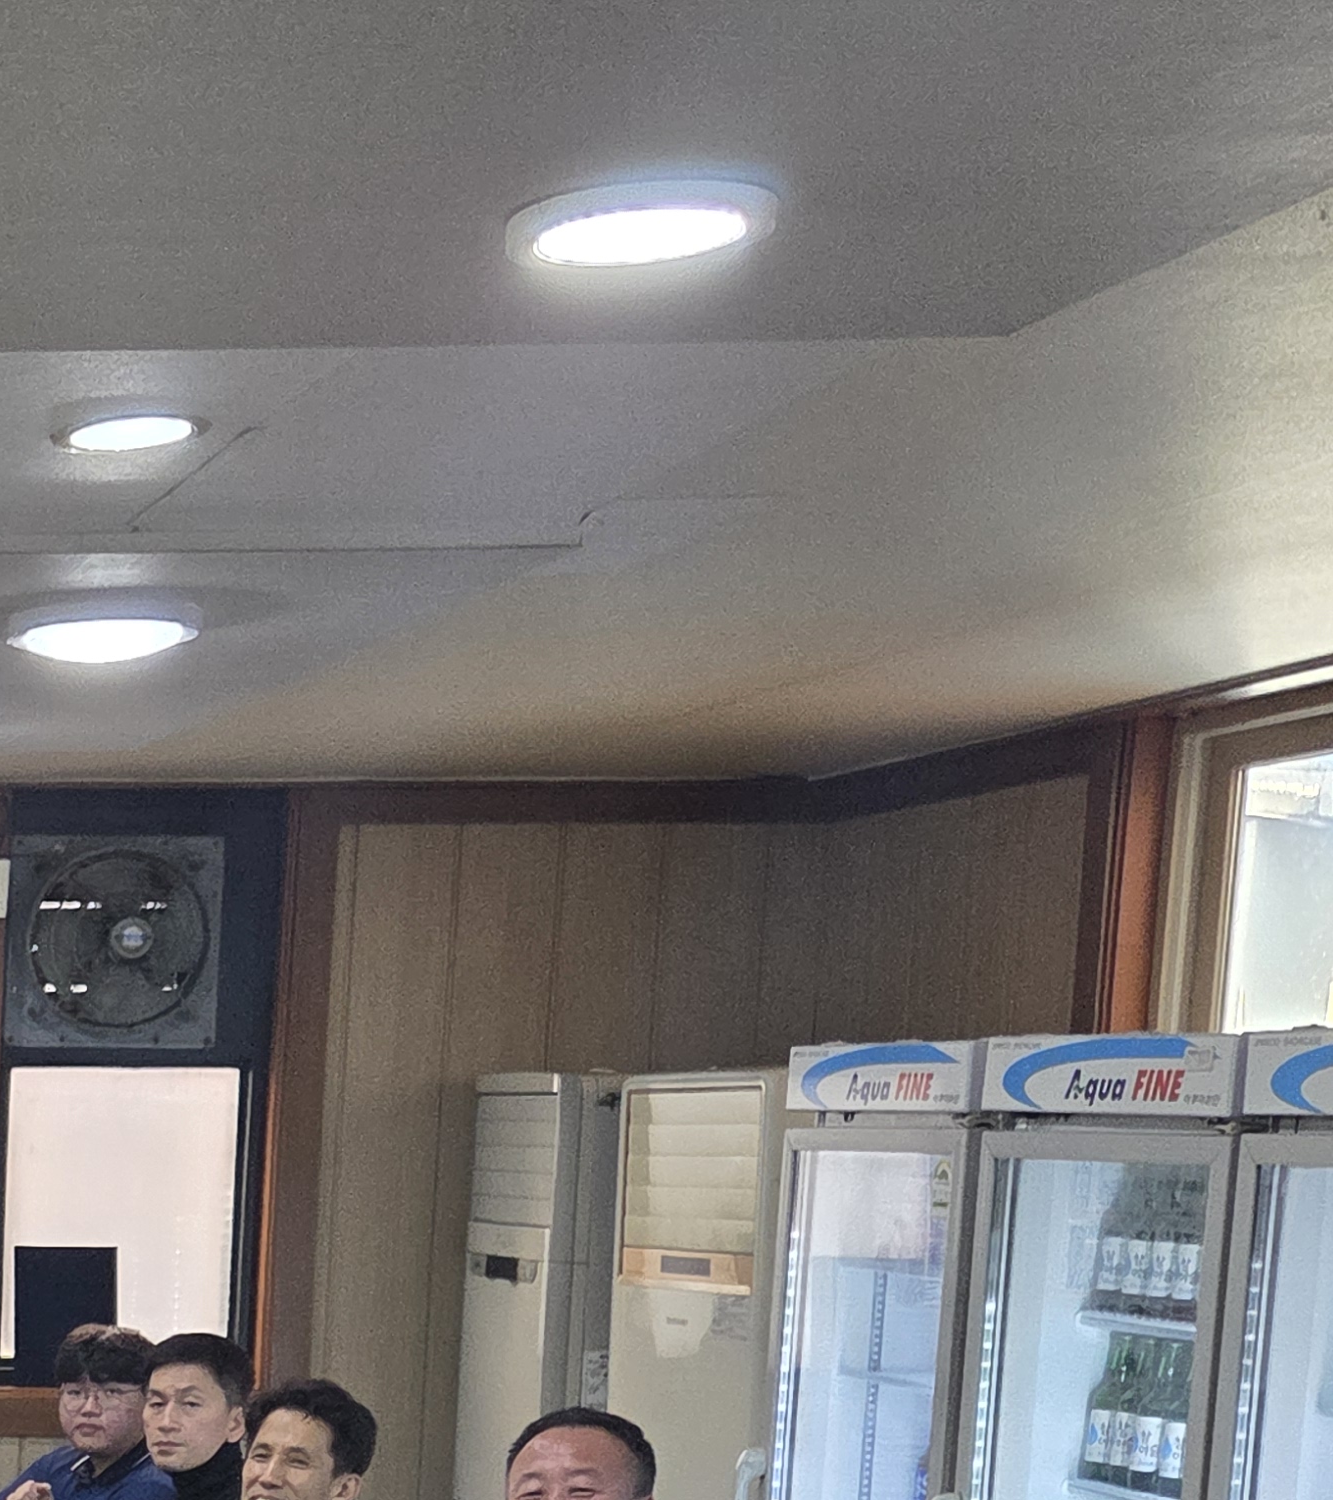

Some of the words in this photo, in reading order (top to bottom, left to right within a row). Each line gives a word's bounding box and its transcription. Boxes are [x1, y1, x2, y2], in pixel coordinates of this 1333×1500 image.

[845, 1072, 891, 1105] Aqua
[895, 1072, 934, 1101] FINE
[1065, 1069, 1126, 1106] Aqua
[1132, 1069, 1185, 1102] FINE
